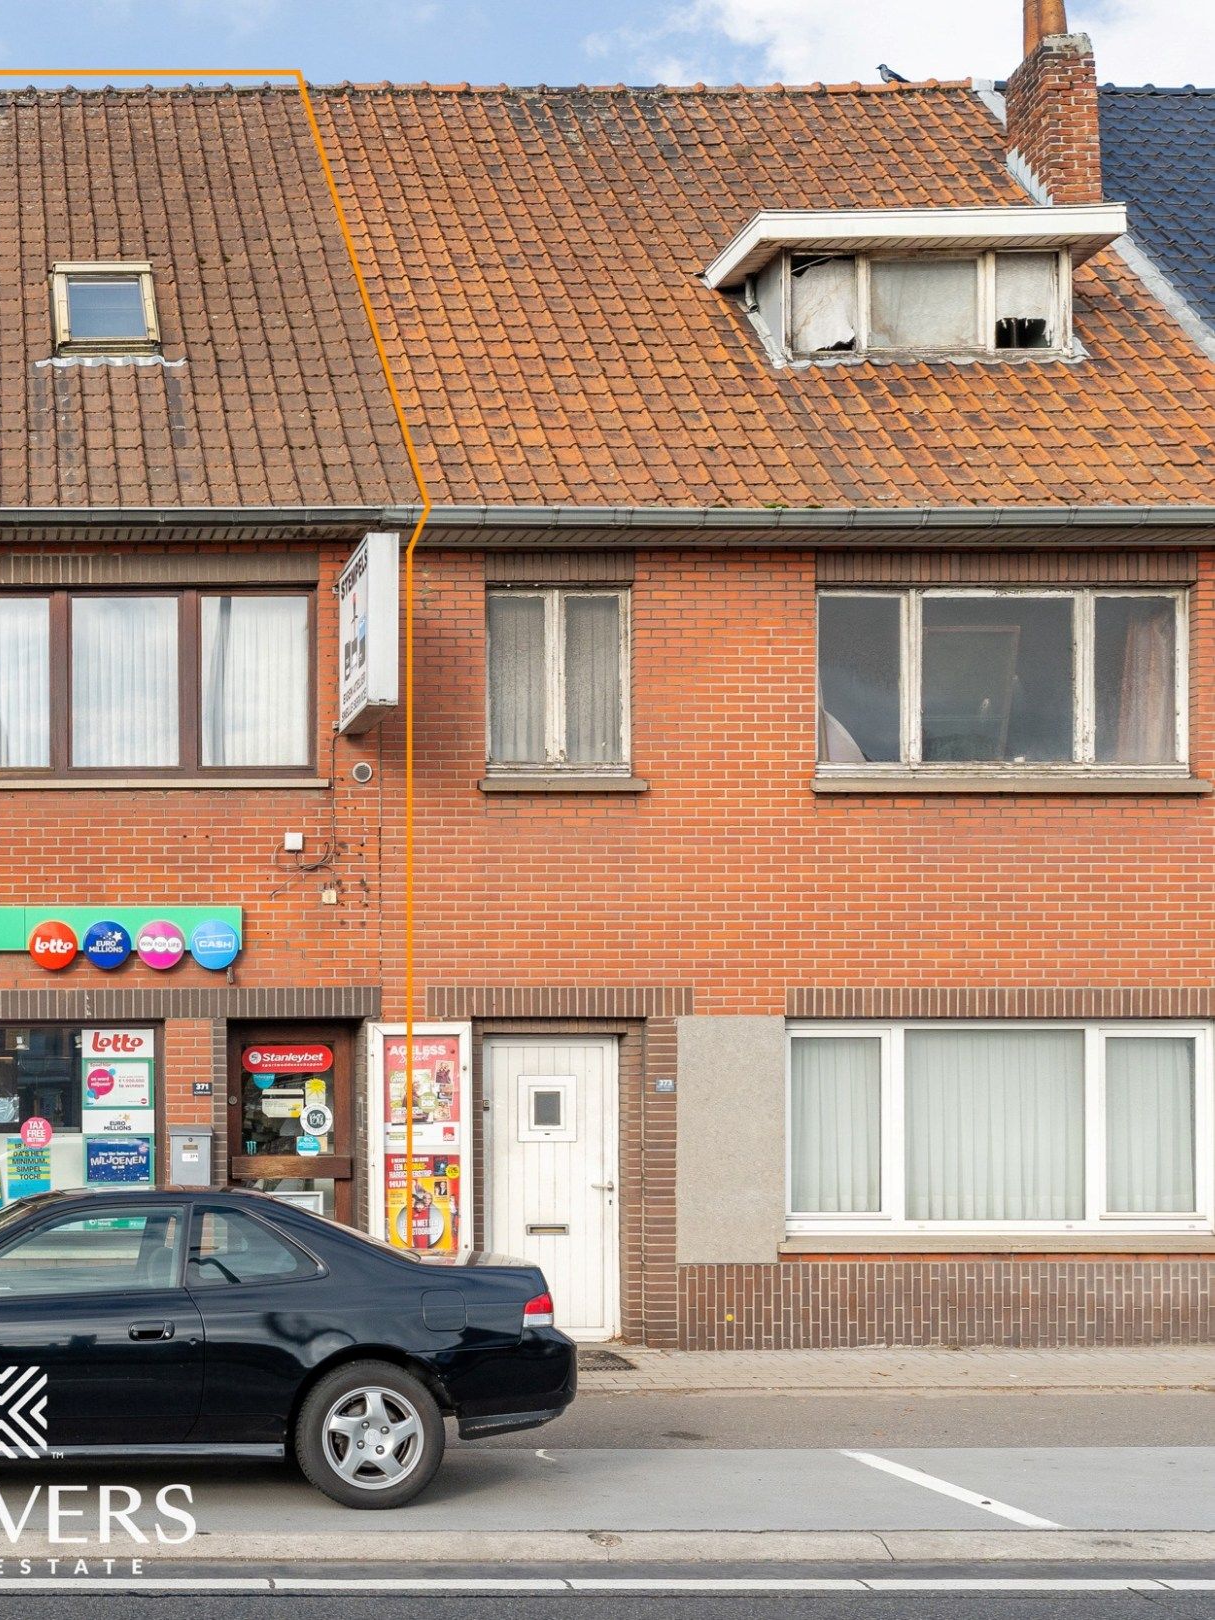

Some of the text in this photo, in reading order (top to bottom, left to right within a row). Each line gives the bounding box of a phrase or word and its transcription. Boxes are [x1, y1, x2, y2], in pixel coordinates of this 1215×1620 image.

[341, 548, 368, 601] STEMPELS
[198, 940, 232, 949] CASH
[88, 945, 124, 954] MILLIONS
[262, 1052, 324, 1063] Stanleybet
[28, 1120, 44, 1130] TAX
[26, 1129, 46, 1138] FREE
[90, 1155, 147, 1166] MILJOENEN
[16, 1165, 42, 1173] SIMPEL
